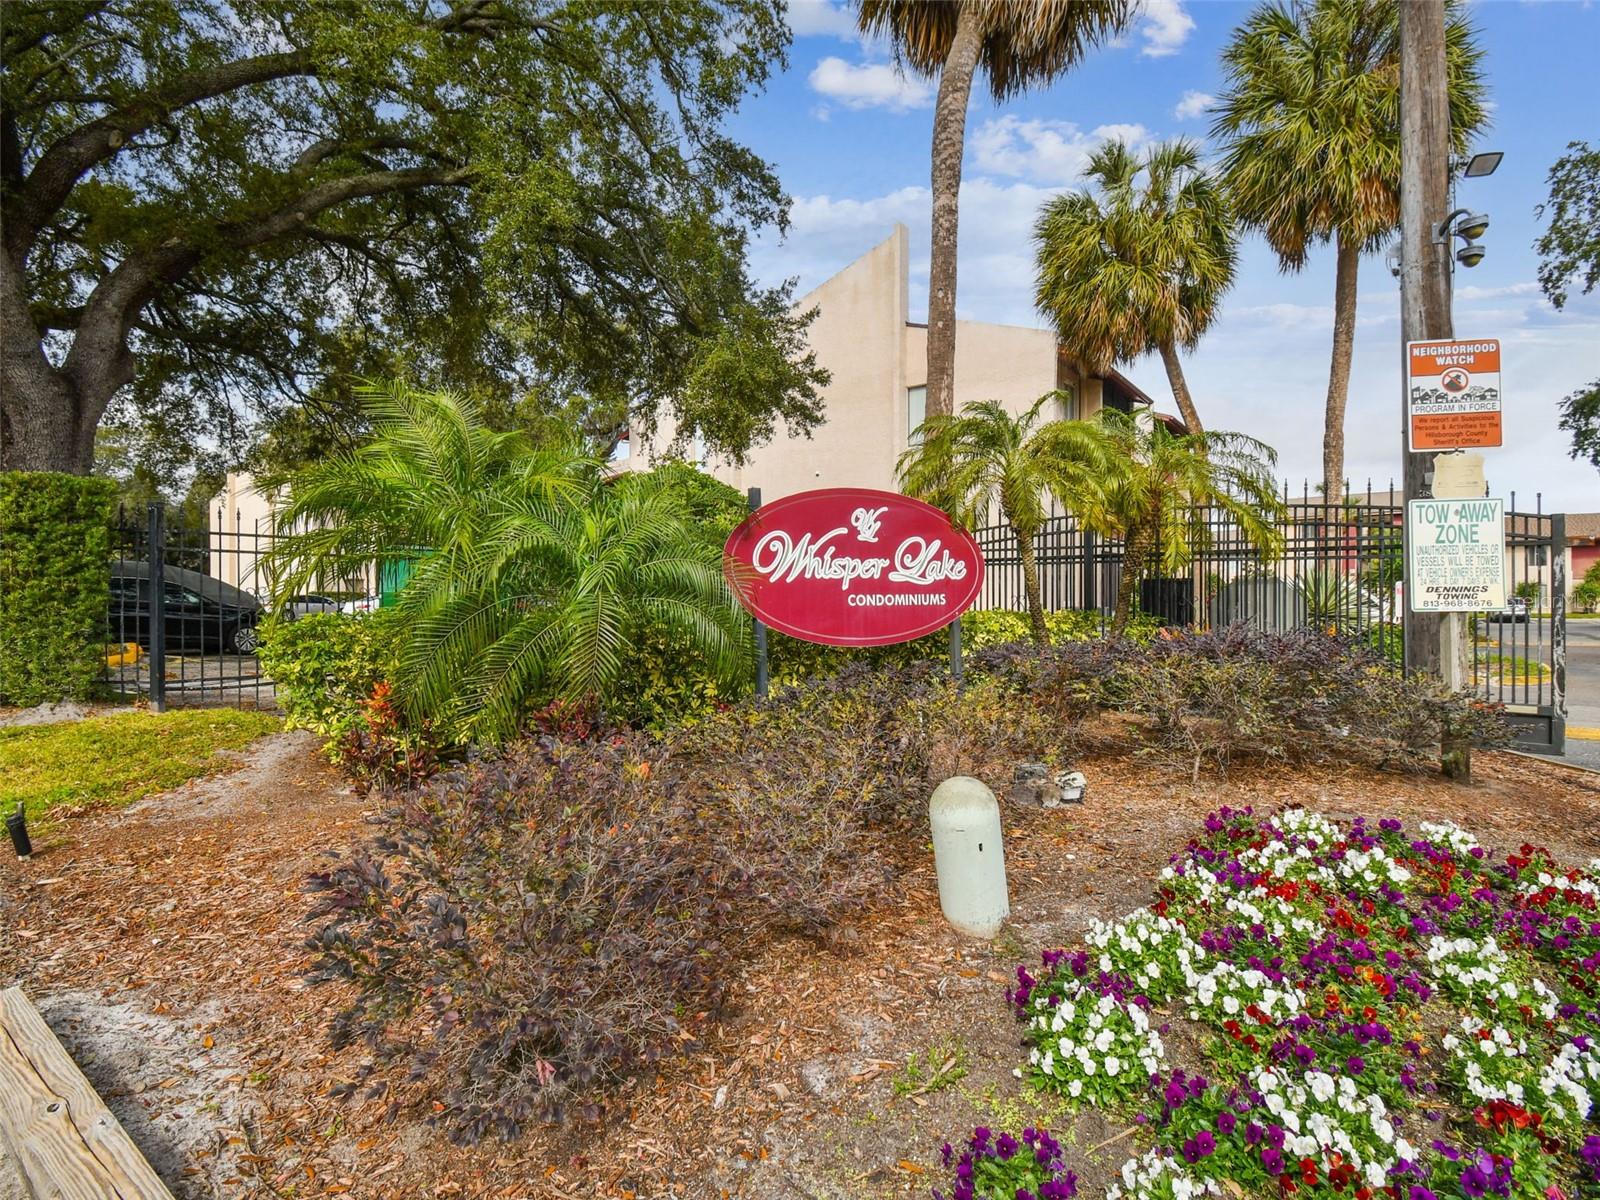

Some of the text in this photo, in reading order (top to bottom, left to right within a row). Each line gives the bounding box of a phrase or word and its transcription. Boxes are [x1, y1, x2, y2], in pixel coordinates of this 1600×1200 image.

[1412, 343, 1497, 357] NEIGHBORHOOD
[1436, 355, 1474, 366] WATCH
[1415, 404, 1455, 413] PROGRAM
[1469, 402, 1497, 411] FORCE
[1415, 502, 1498, 524] TOW AWAY
[1435, 524, 1480, 544] ZONE
[1416, 543, 1499, 556] UNAUTHORIZED VEHICLES OR
[752, 527, 967, 591] Whisper Lake
[1416, 555, 1499, 567] VESSELS WILL BE TOWED
[1426, 567, 1448, 578] VEHICLE
[1425, 585, 1489, 593] DENNINGS
[848, 593, 946, 607] CONDOMINIUMS
[1423, 600, 1493, 608] 813-968-8676
